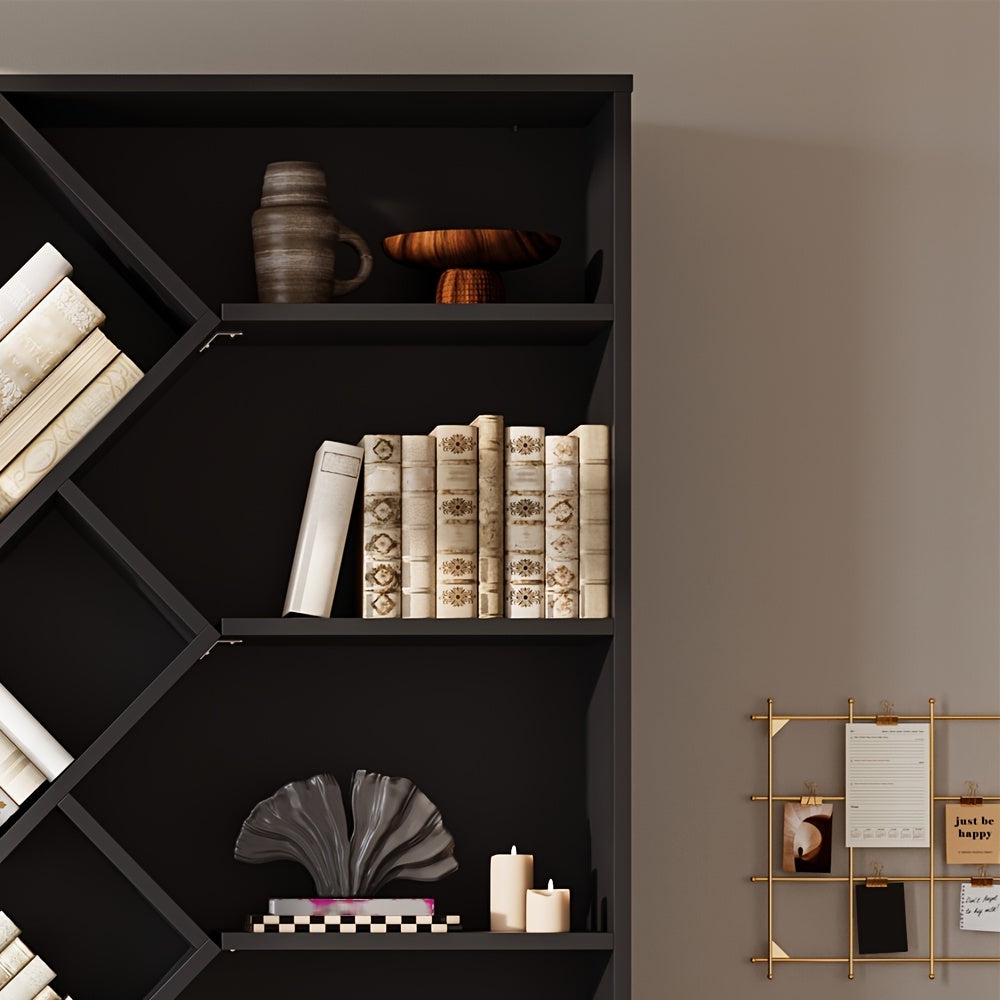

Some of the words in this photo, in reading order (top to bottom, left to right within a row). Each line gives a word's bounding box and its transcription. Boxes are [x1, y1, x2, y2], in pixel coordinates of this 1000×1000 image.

[954, 816, 977, 828] just
[981, 816, 995, 826] be
[958, 829, 992, 840] happy
